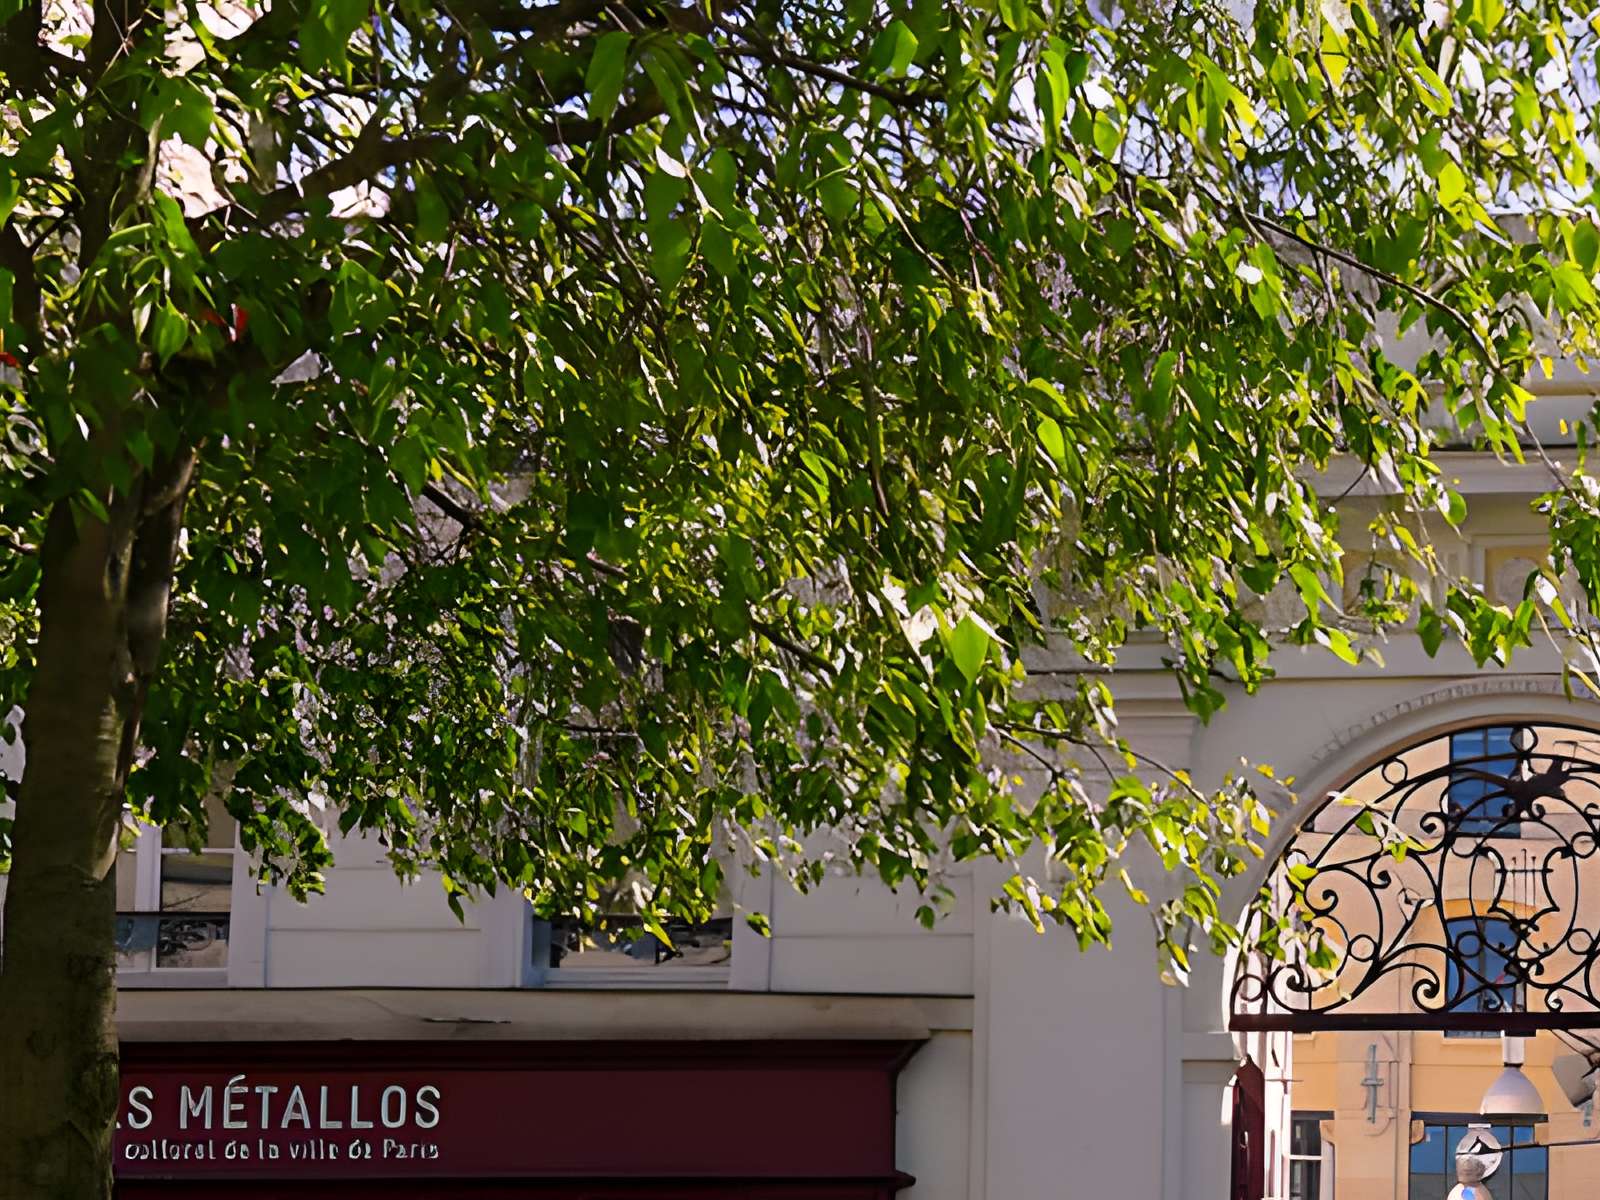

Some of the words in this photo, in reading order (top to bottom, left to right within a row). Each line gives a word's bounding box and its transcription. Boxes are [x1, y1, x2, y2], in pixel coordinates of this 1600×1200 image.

[179, 1074, 441, 1130] MÉTALLOS
[289, 1138, 339, 1160] ville
[383, 1138, 439, 1160] Paris
